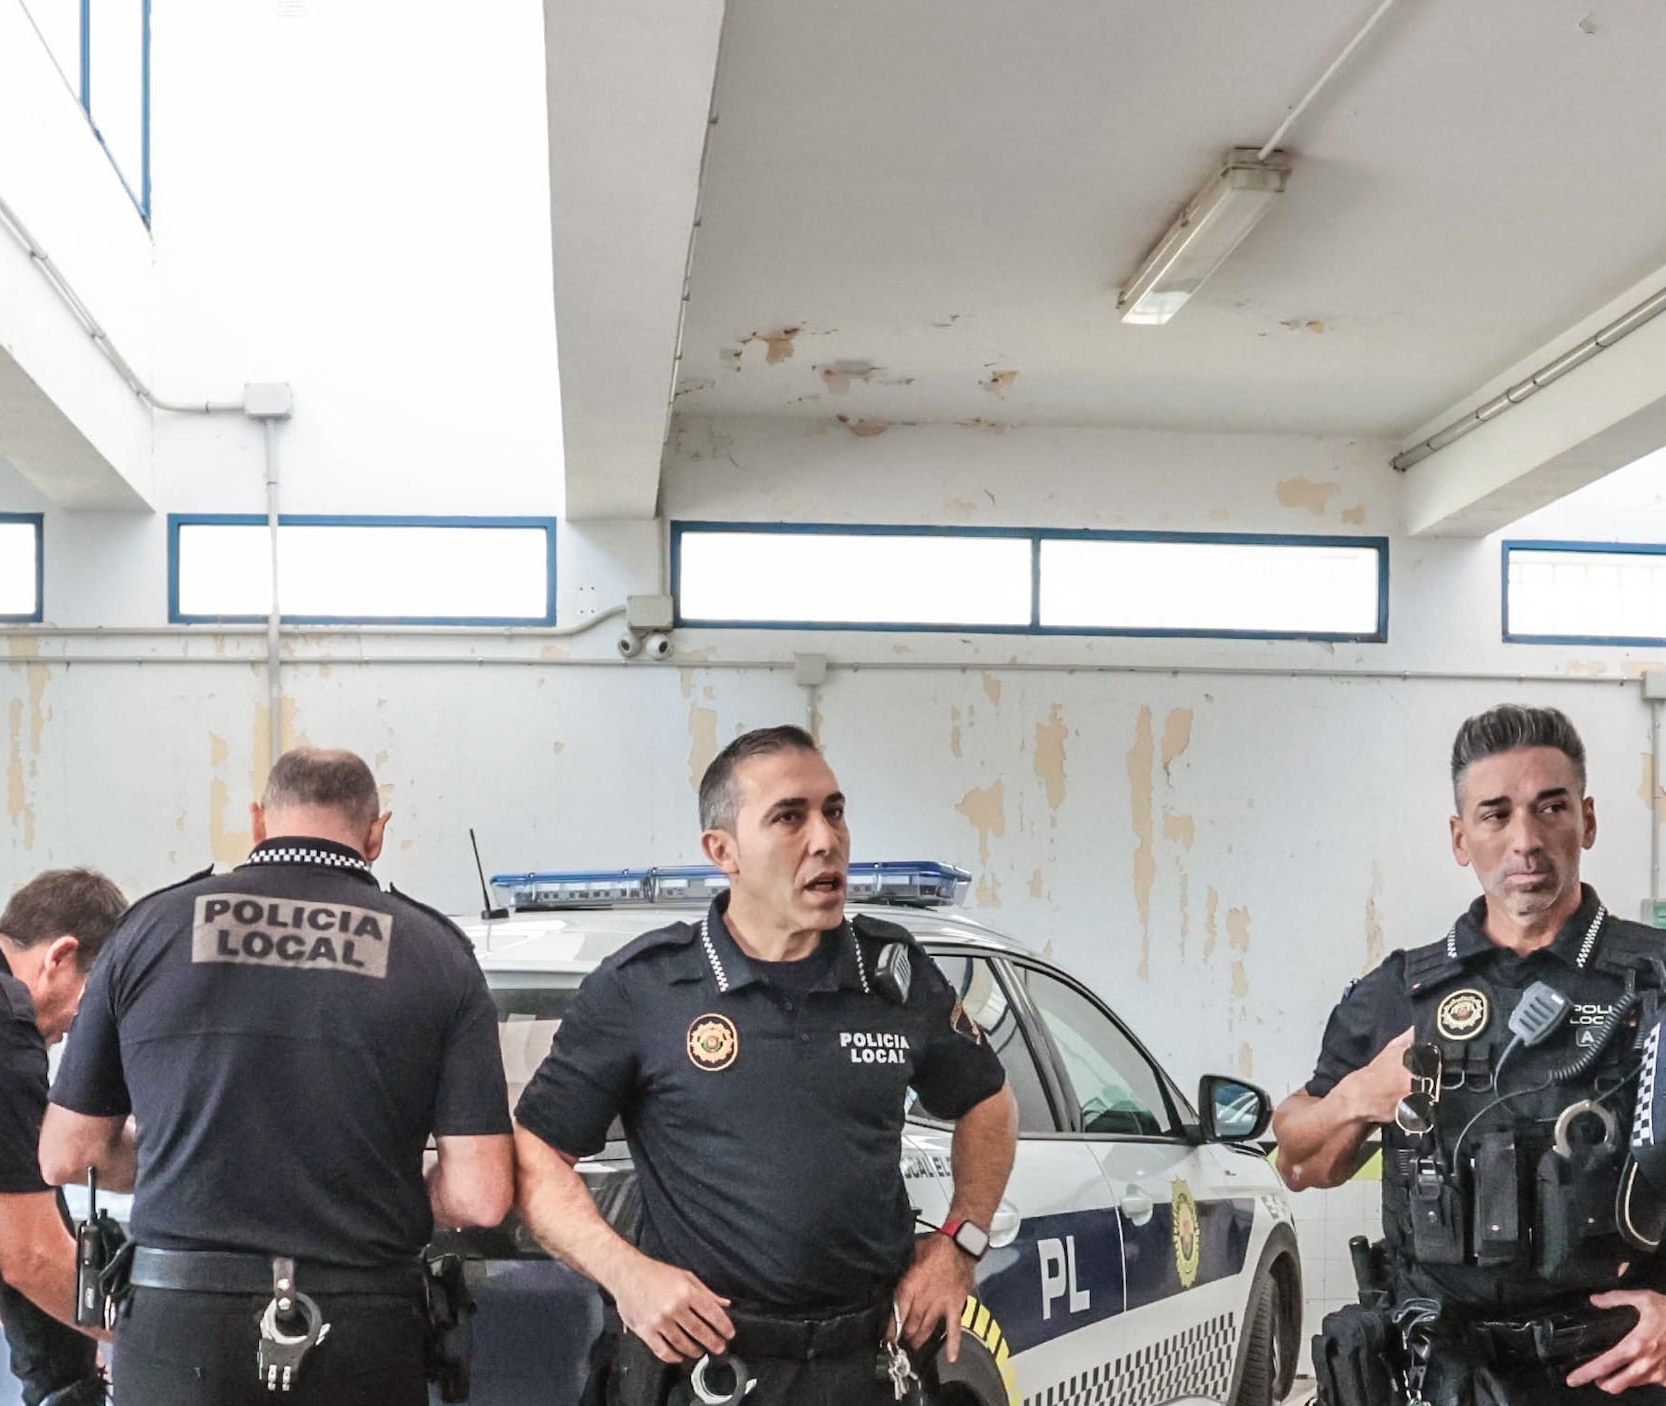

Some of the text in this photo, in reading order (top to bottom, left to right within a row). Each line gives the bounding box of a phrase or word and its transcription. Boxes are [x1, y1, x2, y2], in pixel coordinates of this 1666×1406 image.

[204, 899, 383, 941] POLICIA
[217, 929, 365, 968] LOCAL
[1573, 1004, 1613, 1014] POLI
[1570, 1015, 1605, 1025] LOC
[839, 1032, 910, 1049] POLICIA
[851, 1048, 906, 1063] LOCAL
[1037, 1235, 1091, 1320] PL
